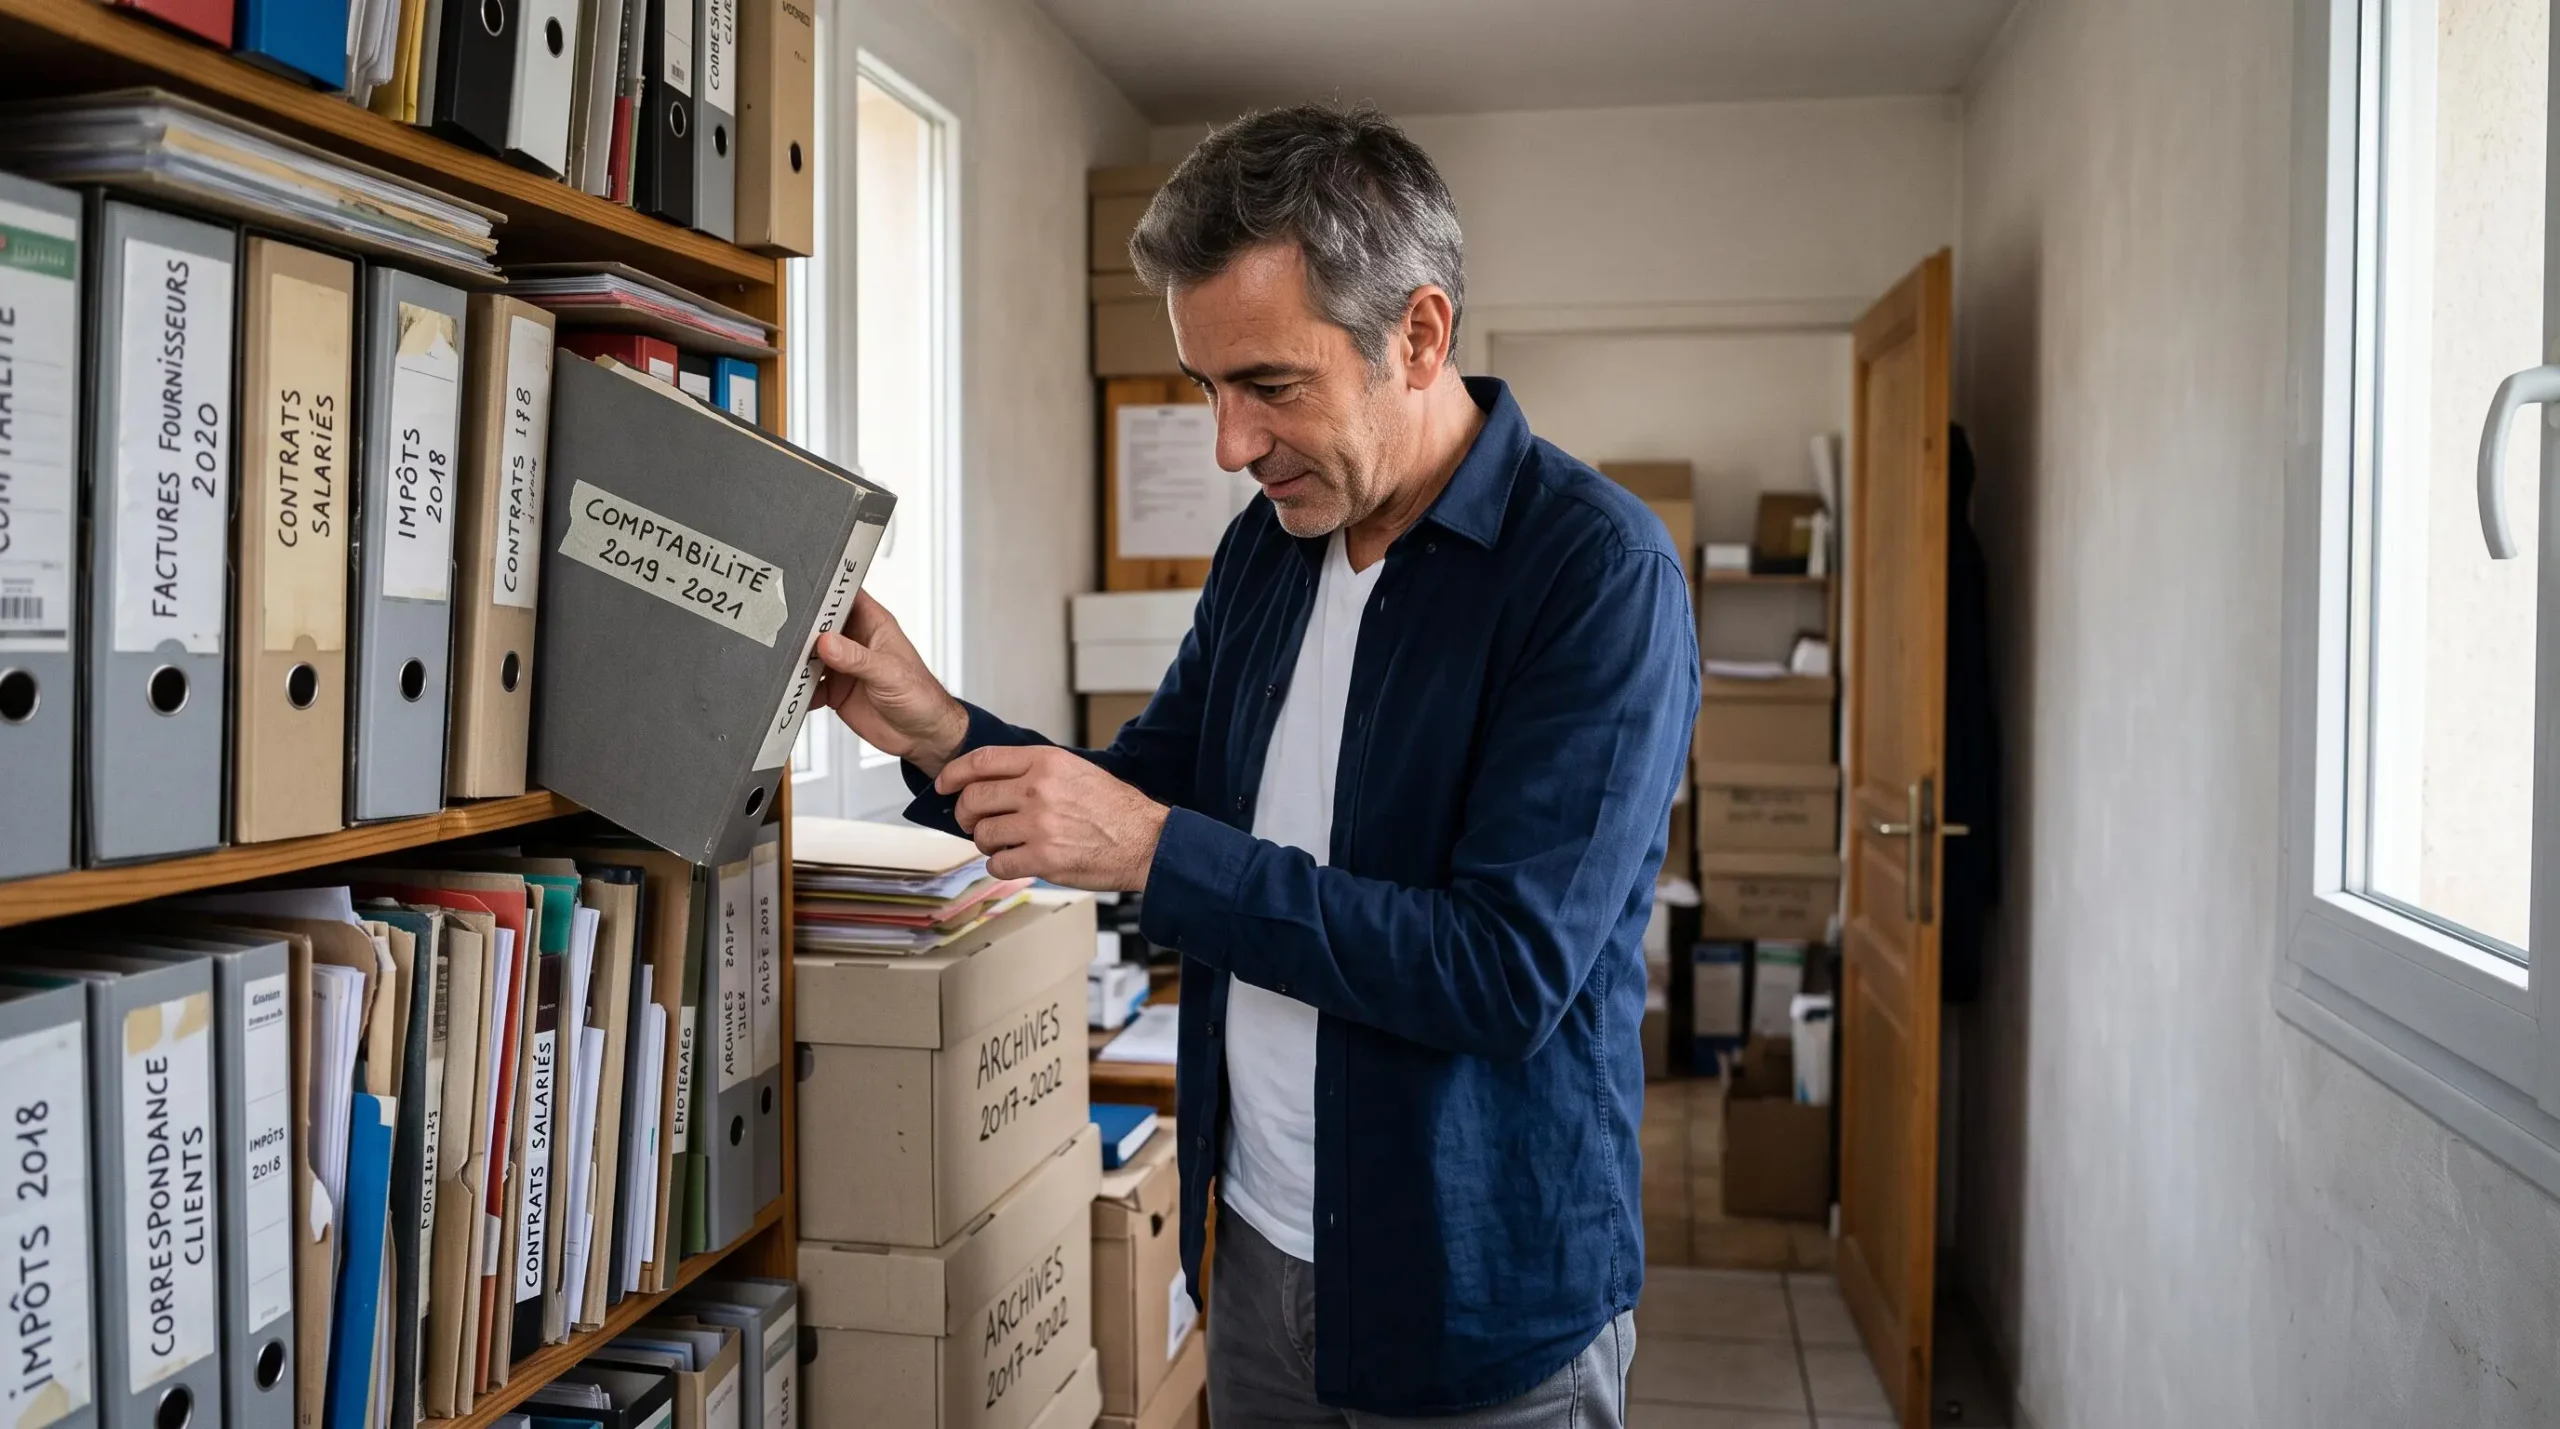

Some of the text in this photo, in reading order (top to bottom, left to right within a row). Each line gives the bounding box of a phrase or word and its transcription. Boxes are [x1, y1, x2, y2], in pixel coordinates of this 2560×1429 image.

[193, 403, 218, 498] 2020
[278, 389, 301, 548] CONTRATS
[396, 428, 421, 539] IMPÔTS
[426, 449, 447, 524] 2018
[153, 472, 181, 619] FACTURES
[504, 454, 525, 593] CONTRATS
[599, 538, 659, 582] 2019
[682, 577, 743, 620] 2021
[16, 1100, 50, 1200] 2018
[979, 1056, 1063, 1143] 2017-2022
[146, 1055, 175, 1357] CORRESPONDANCE
[183, 1125, 205, 1266] CLIENTS
[252, 1155, 282, 1180] 2018
[525, 1041, 552, 1288] CONTRATS SALARIÉS
[985, 1295, 1070, 1411] 2017-2022
